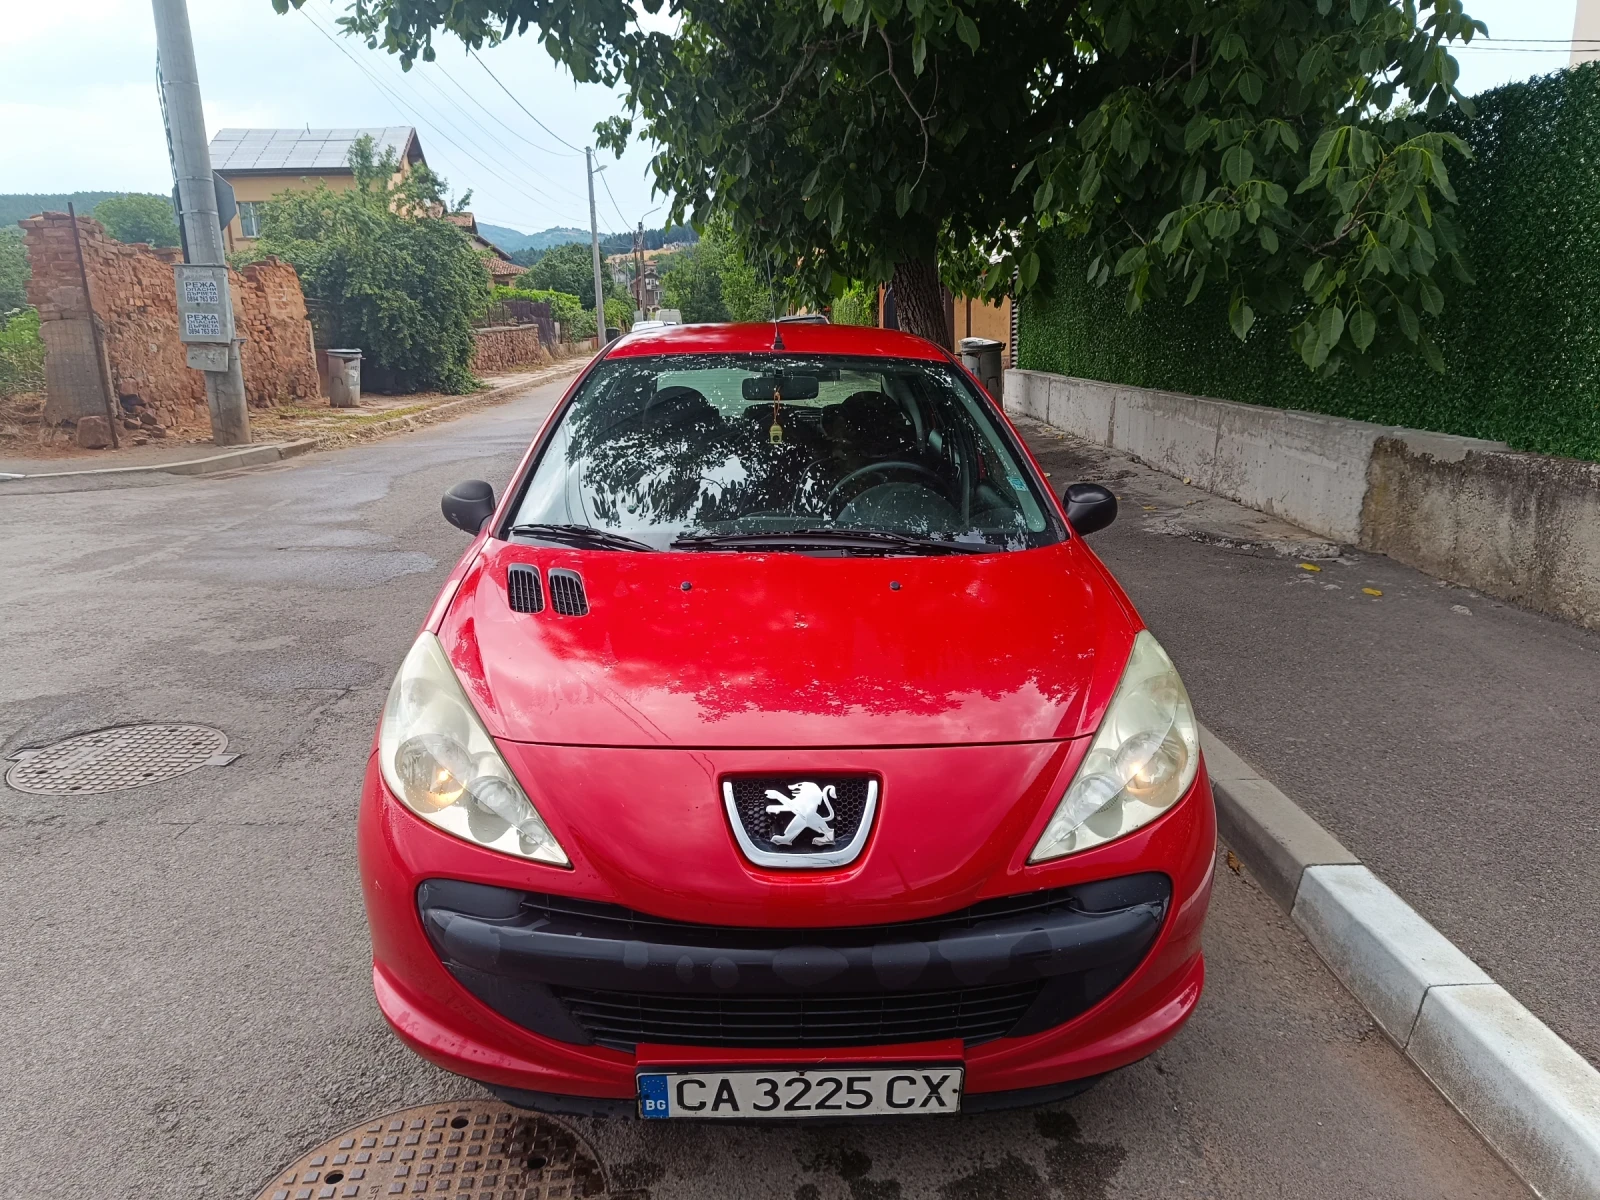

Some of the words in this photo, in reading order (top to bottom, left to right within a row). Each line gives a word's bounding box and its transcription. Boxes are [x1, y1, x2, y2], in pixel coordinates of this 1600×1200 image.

[645, 1099, 667, 1111] BG
[675, 1078, 740, 1112] CA
[752, 1076, 873, 1111] 3225
[885, 1074, 951, 1109] CX
